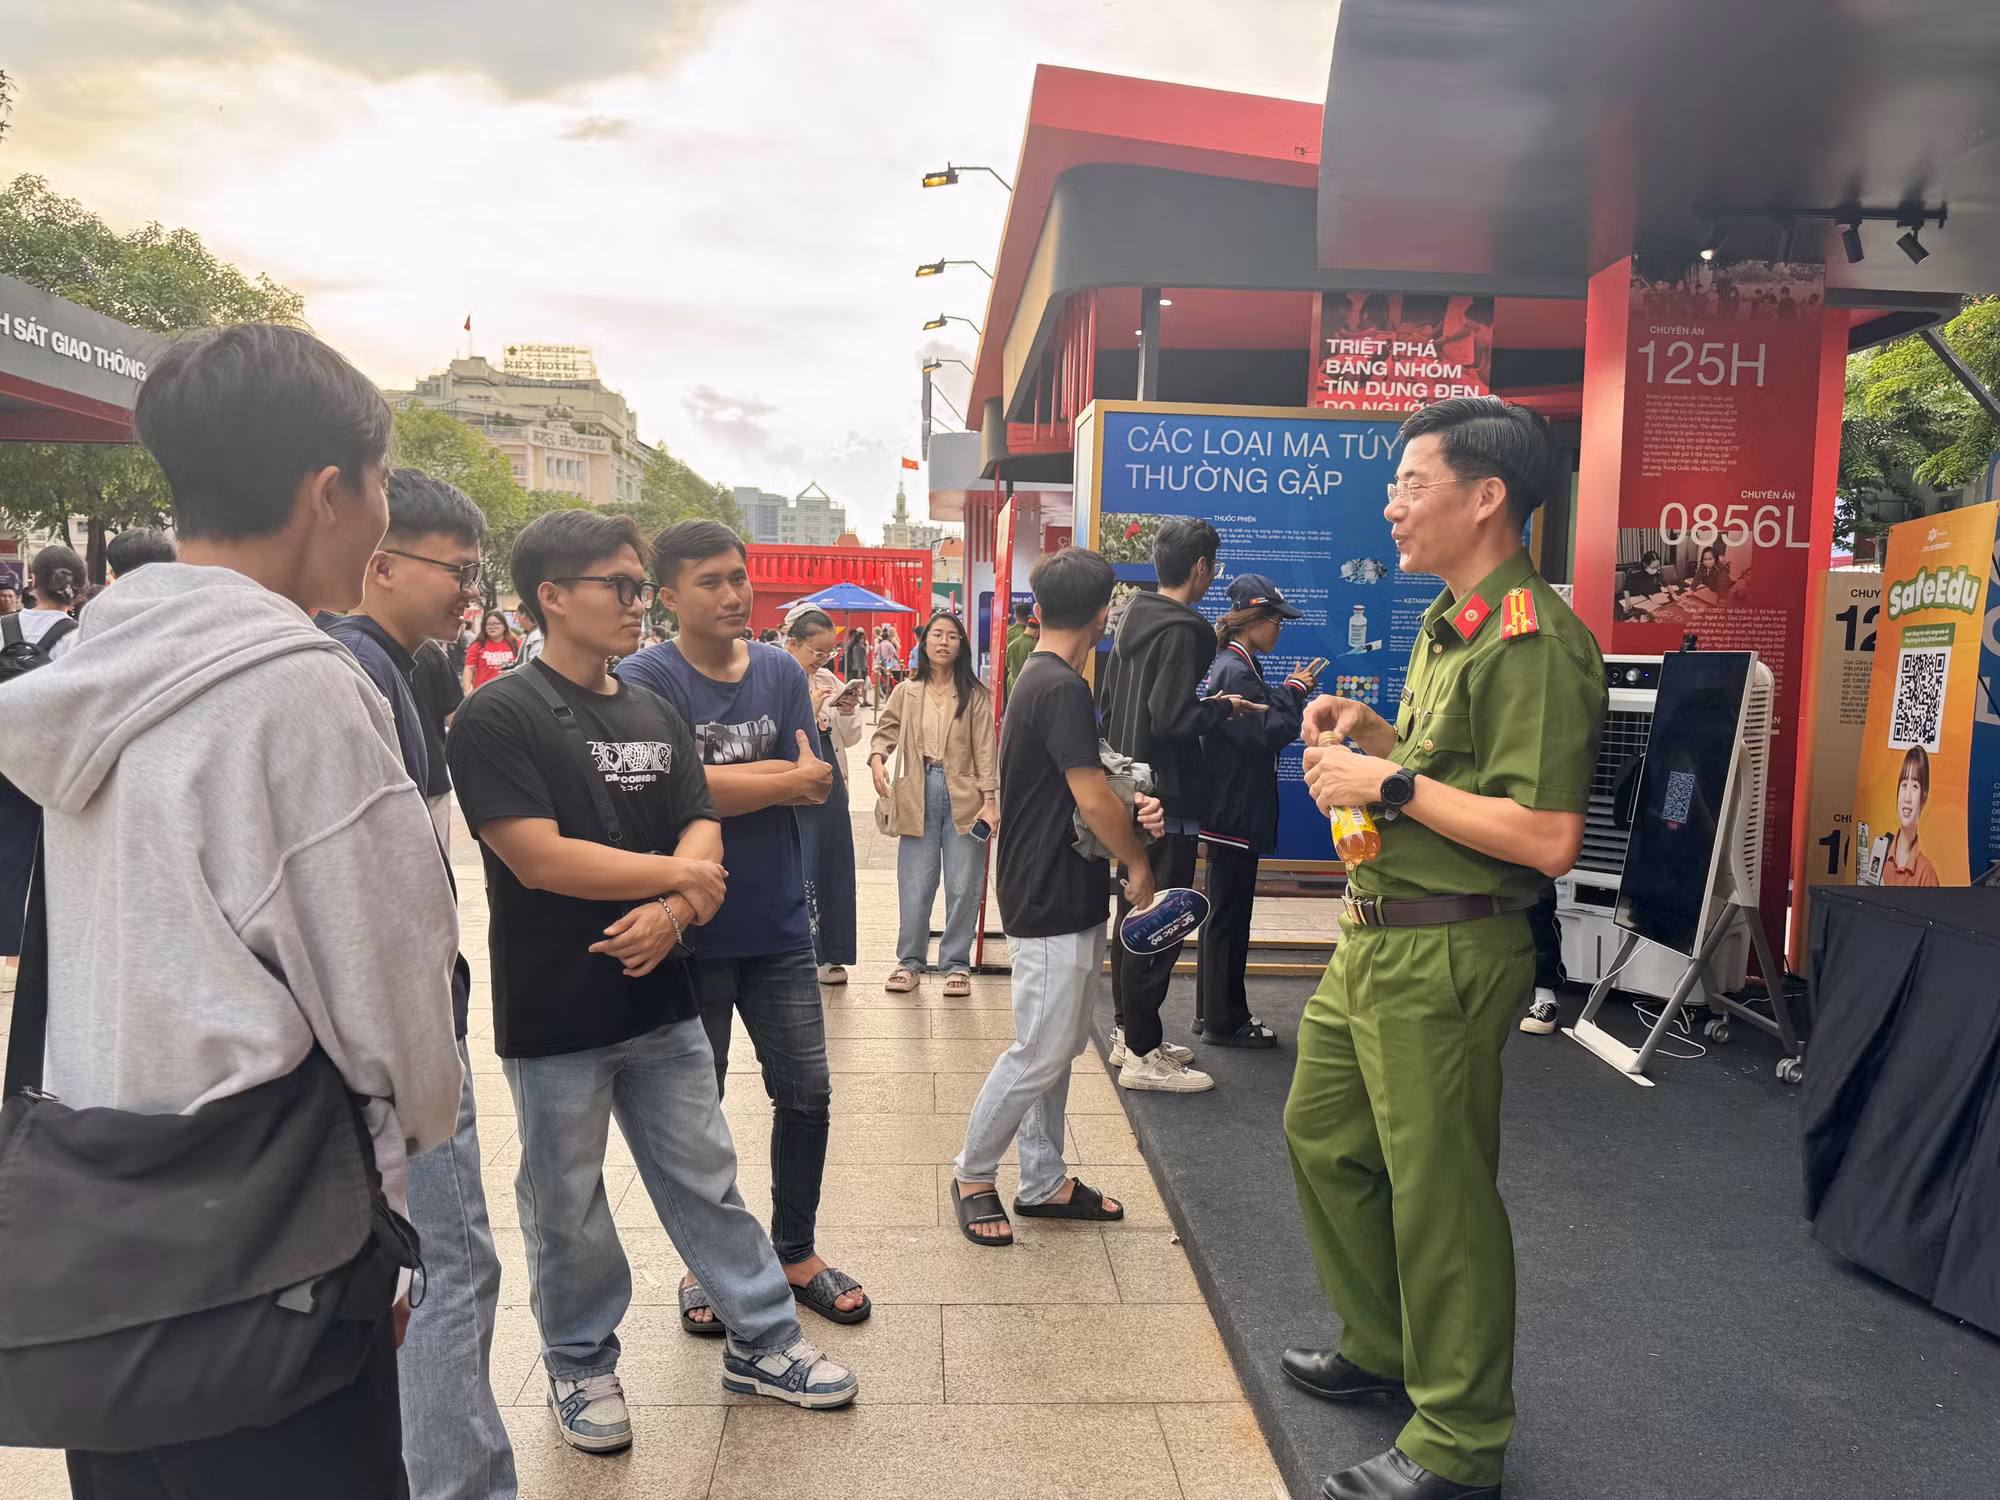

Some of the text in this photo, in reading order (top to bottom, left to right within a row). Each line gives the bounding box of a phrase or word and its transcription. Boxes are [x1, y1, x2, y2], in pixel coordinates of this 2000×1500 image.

[1650, 325, 1704, 336] CHUYÊN ÁN
[13, 316, 48, 347] SÁT
[51, 331, 92, 364] GIAO
[94, 346, 147, 382] THÔNG
[1326, 337, 1438, 358] TRIỆT PHÁ
[1326, 357, 1462, 378] BĂNG NHÓM
[1638, 340, 1766, 386] 125H
[1324, 376, 1480, 400] TÍN DỤNG ĐEN
[1362, 400, 1433, 412] NGƯỜ
[1127, 421, 1400, 462] CÁC LOẠI MA TÚY
[1125, 461, 1344, 500] THƯỜNG GẶP
[1740, 489, 1795, 500] CHUYÊN ÁN
[1237, 515, 1256, 523] PHIỆN
[1660, 502, 1810, 548] 0856L
[1850, 589, 1881, 598] CHUY
[1889, 569, 1980, 617] SafeEdu
[1836, 605, 1880, 652] 12
